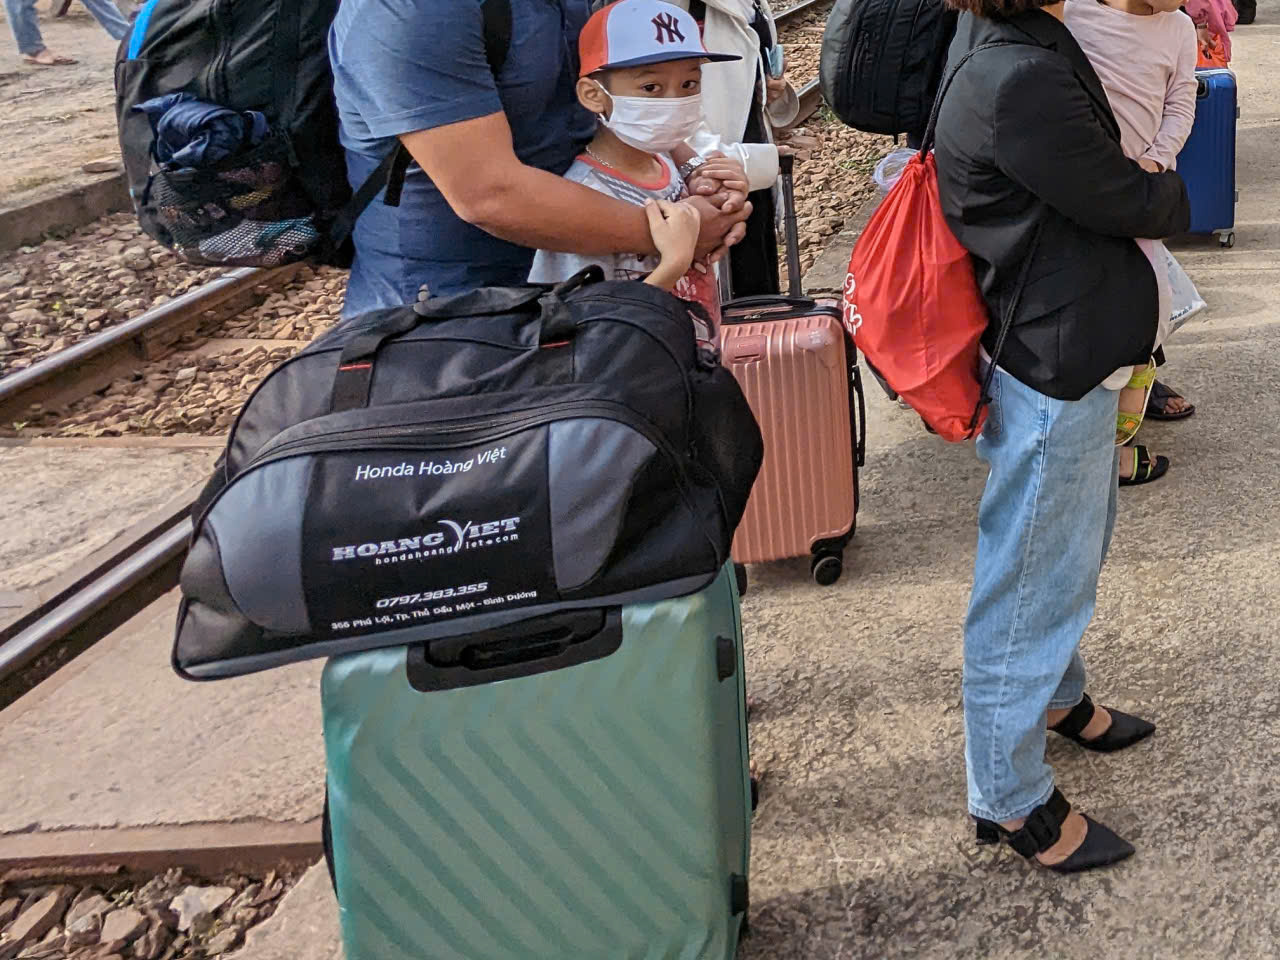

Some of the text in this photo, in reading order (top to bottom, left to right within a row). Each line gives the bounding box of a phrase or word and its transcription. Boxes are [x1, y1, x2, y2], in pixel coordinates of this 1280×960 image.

[651, 12, 685, 45] NY
[355, 446, 507, 481] Honda Hoàng Việt
[332, 532, 444, 561] HOANG
[375, 581, 489, 609] 0797.383.355
